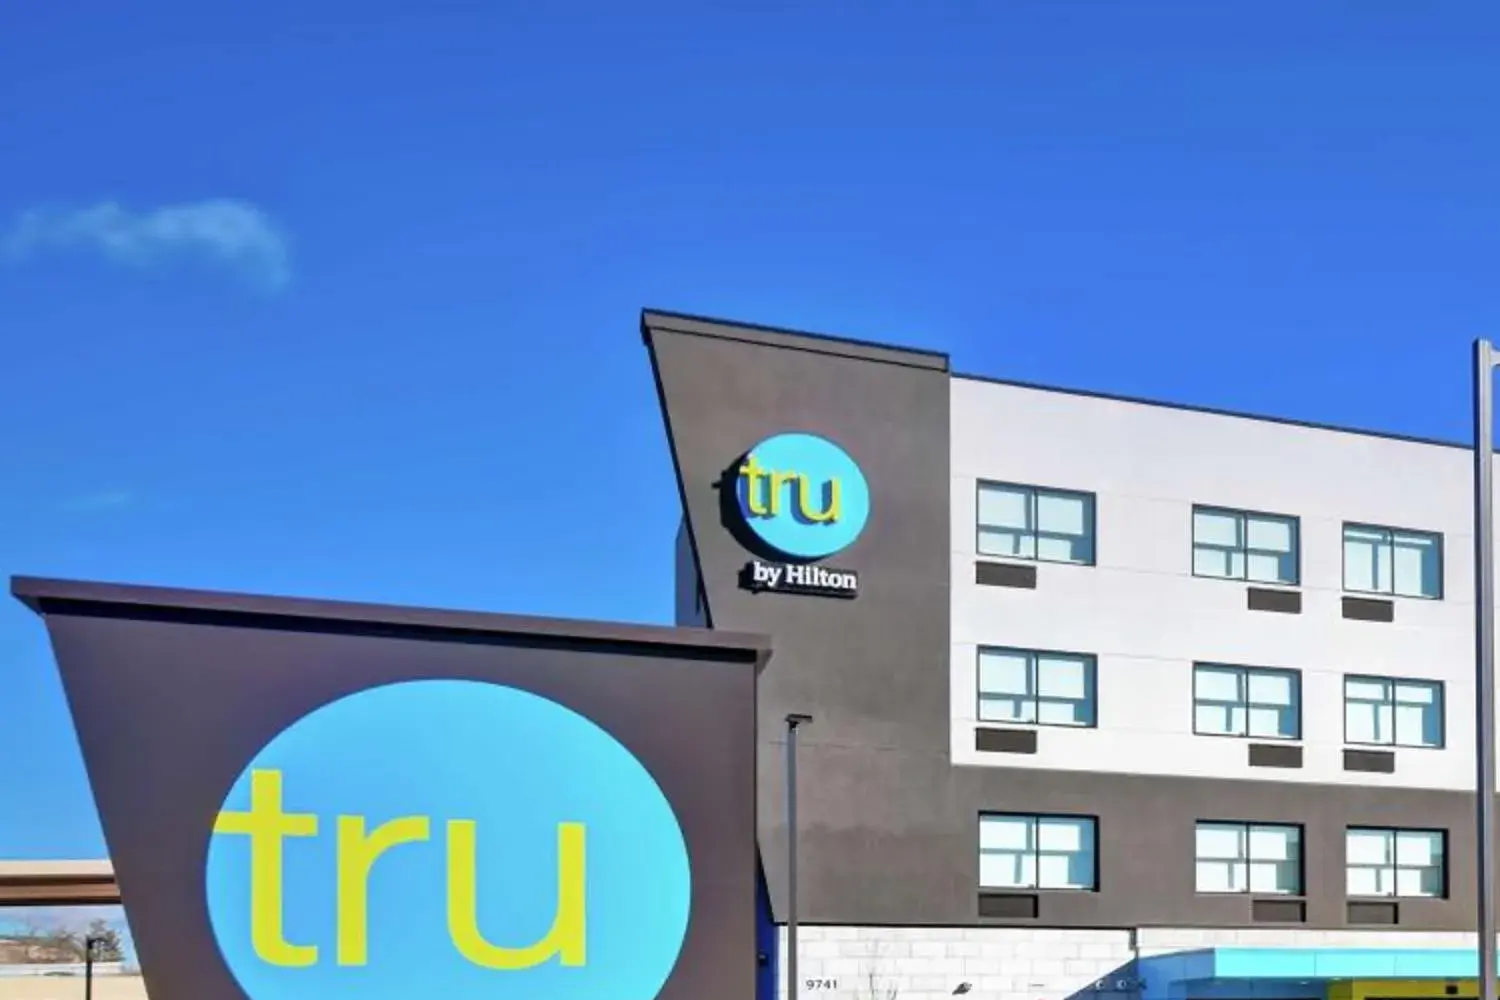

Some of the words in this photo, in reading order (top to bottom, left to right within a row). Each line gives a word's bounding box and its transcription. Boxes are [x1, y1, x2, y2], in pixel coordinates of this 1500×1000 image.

[739, 457, 841, 521] tru
[753, 561, 781, 586] by
[786, 564, 857, 589] Hilton
[213, 769, 587, 969] tru
[806, 979, 837, 990] 9741
